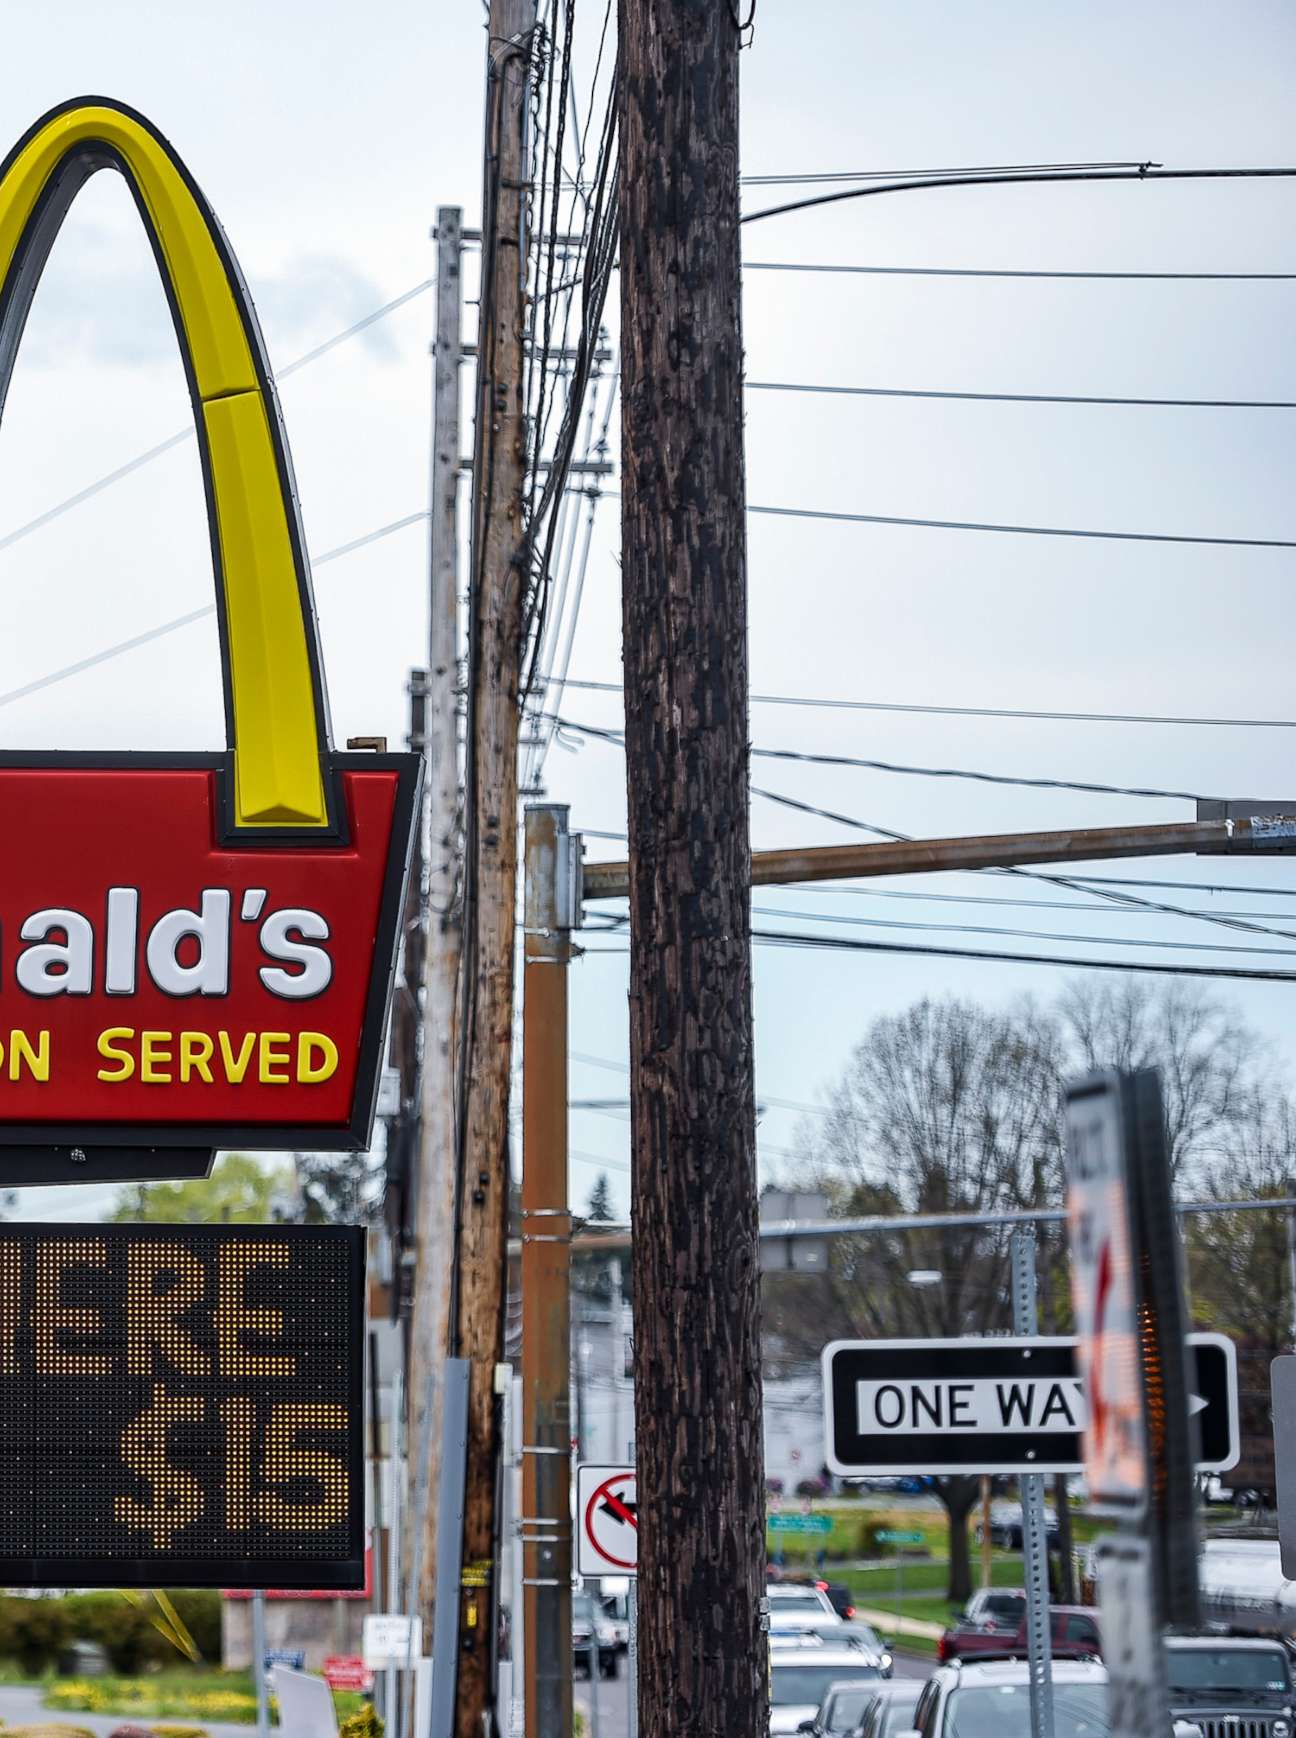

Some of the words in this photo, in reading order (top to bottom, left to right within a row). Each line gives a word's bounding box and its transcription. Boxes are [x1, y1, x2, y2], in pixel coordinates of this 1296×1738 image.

[96, 1027, 340, 1085] SERVED
[874, 1384, 978, 1429] ONE
[113, 1383, 349, 1550] $15
